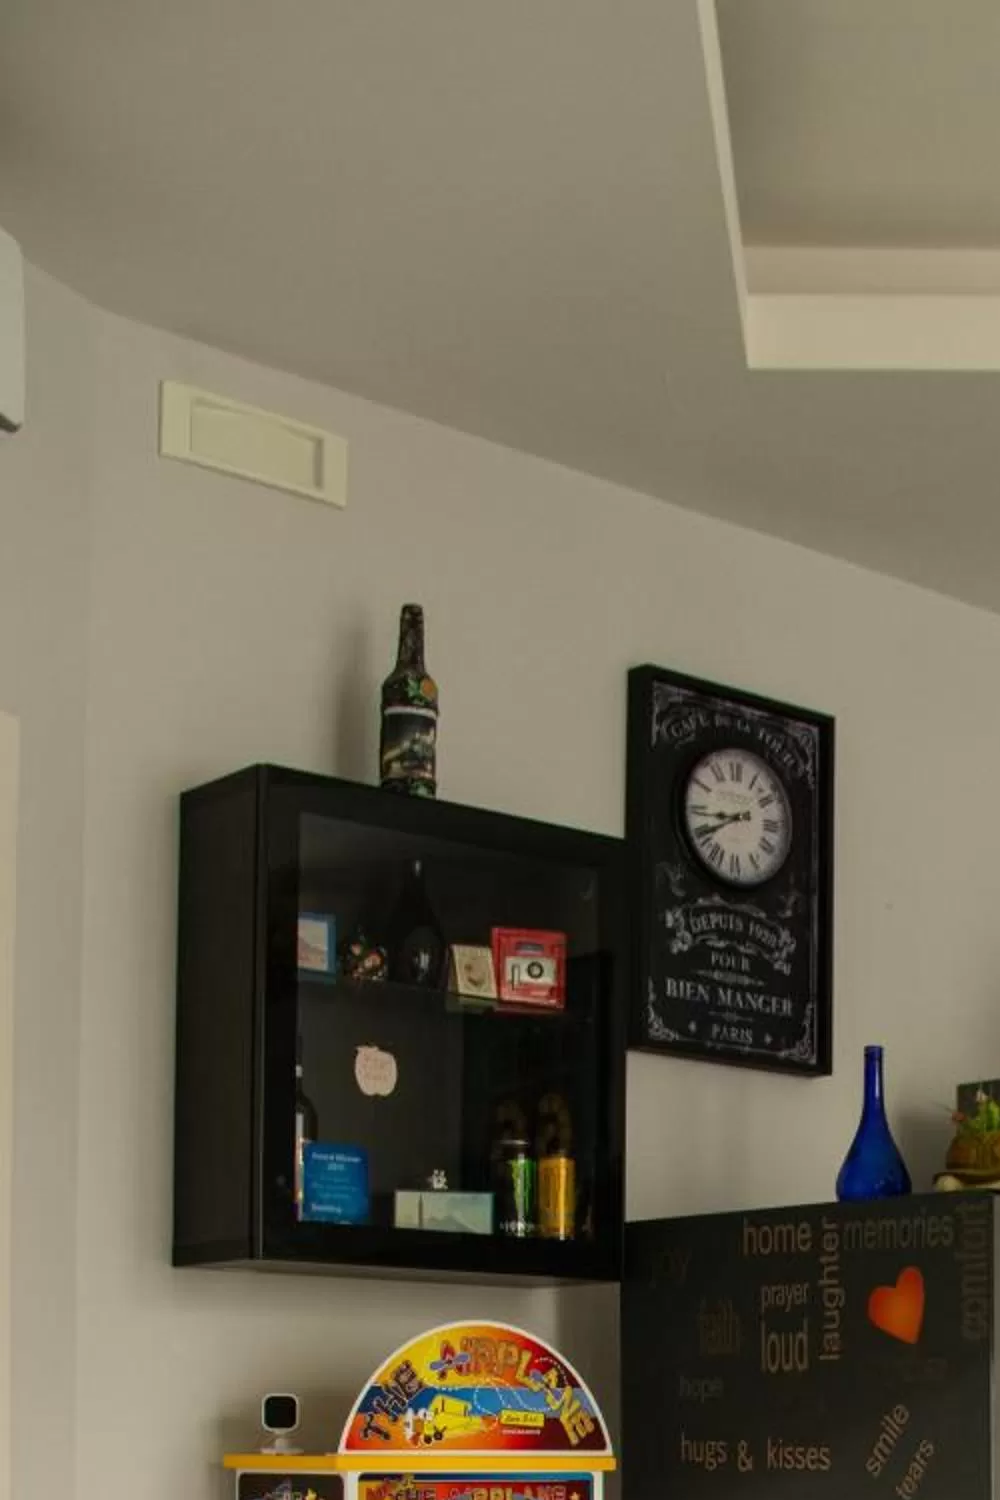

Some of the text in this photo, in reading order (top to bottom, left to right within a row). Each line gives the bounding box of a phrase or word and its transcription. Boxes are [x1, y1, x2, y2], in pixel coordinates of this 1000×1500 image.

[690, 911, 744, 933] DEPUIS
[710, 950, 751, 972] POUR
[665, 977, 793, 1016] BIEN MANGER
[711, 1023, 753, 1045] PARIS
[743, 1218, 812, 1256] home
[843, 1206, 954, 1250] memories
[760, 1281, 809, 1312] prayer
[818, 1218, 846, 1361] laughter
[760, 1316, 810, 1373] loud
[360, 1335, 596, 1447] THE AIRPLANE
[680, 1431, 831, 1472] hugs & kisses
[864, 1403, 910, 1479] smile
